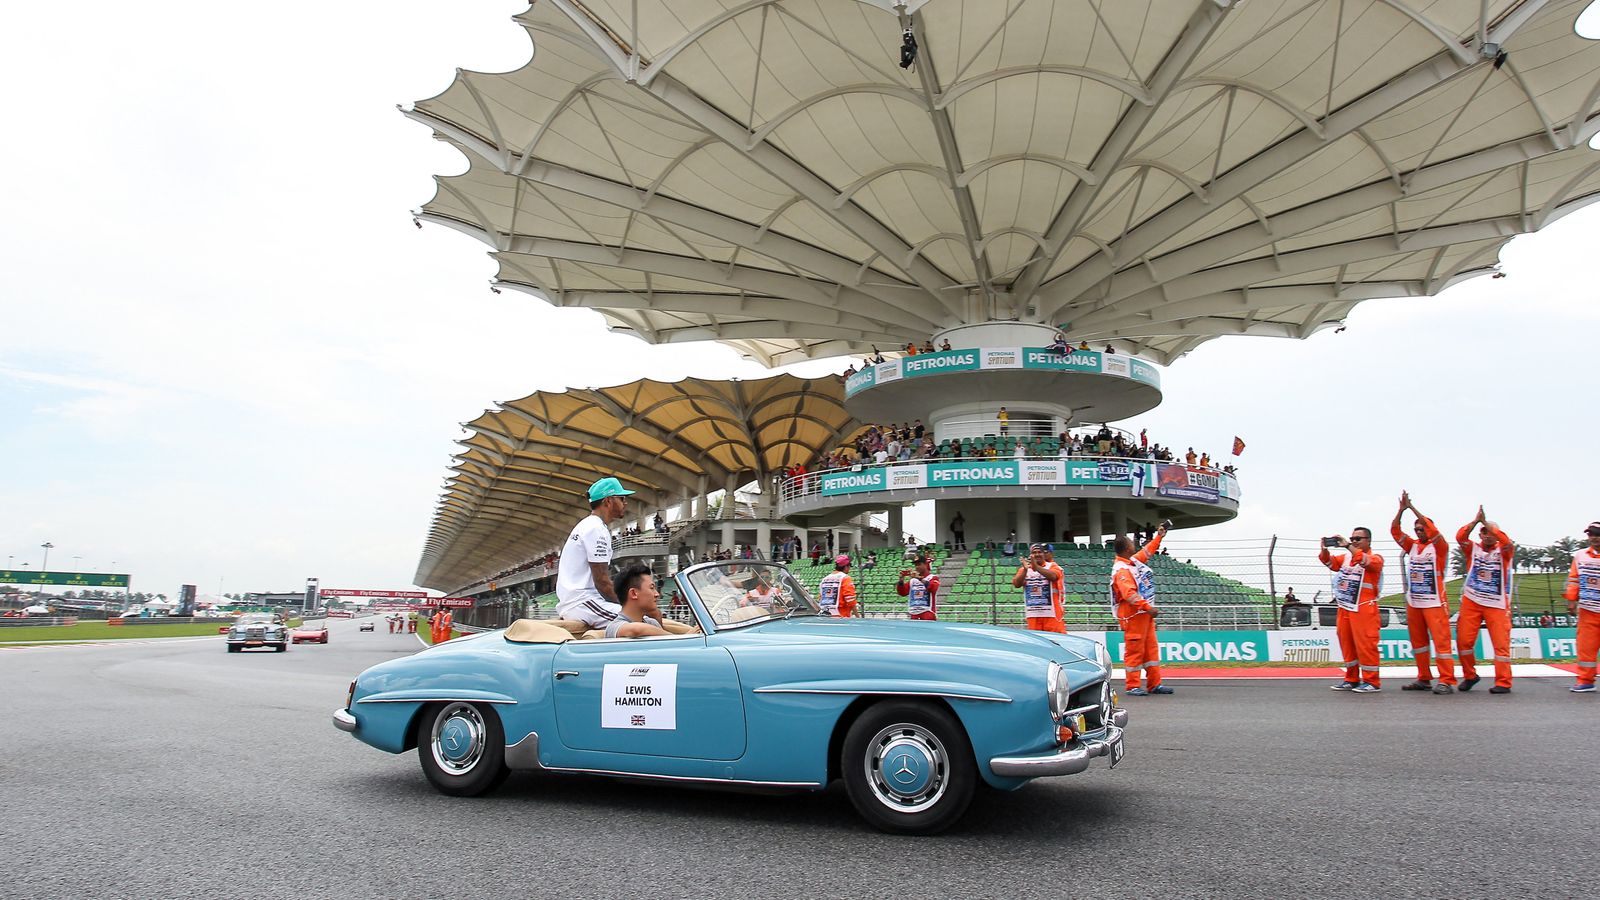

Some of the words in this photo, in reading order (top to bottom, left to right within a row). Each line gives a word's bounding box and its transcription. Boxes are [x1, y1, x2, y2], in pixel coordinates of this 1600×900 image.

[907, 354, 974, 372] PETRONAS
[1028, 353, 1097, 366] PETRONAS
[933, 468, 1014, 481] PETRONAS
[1027, 471, 1057, 480] SYNTIUM
[824, 473, 881, 490] PETRONAS
[428, 598, 441, 606] Fly
[441, 598, 472, 606] Emirates
[1282, 639, 1329, 647] PETRONAS
[1118, 641, 1258, 661] TRONAS
[1284, 648, 1330, 662] SYNTIUM
[625, 685, 652, 695] LEWIS
[614, 697, 662, 706] HAMILTON
